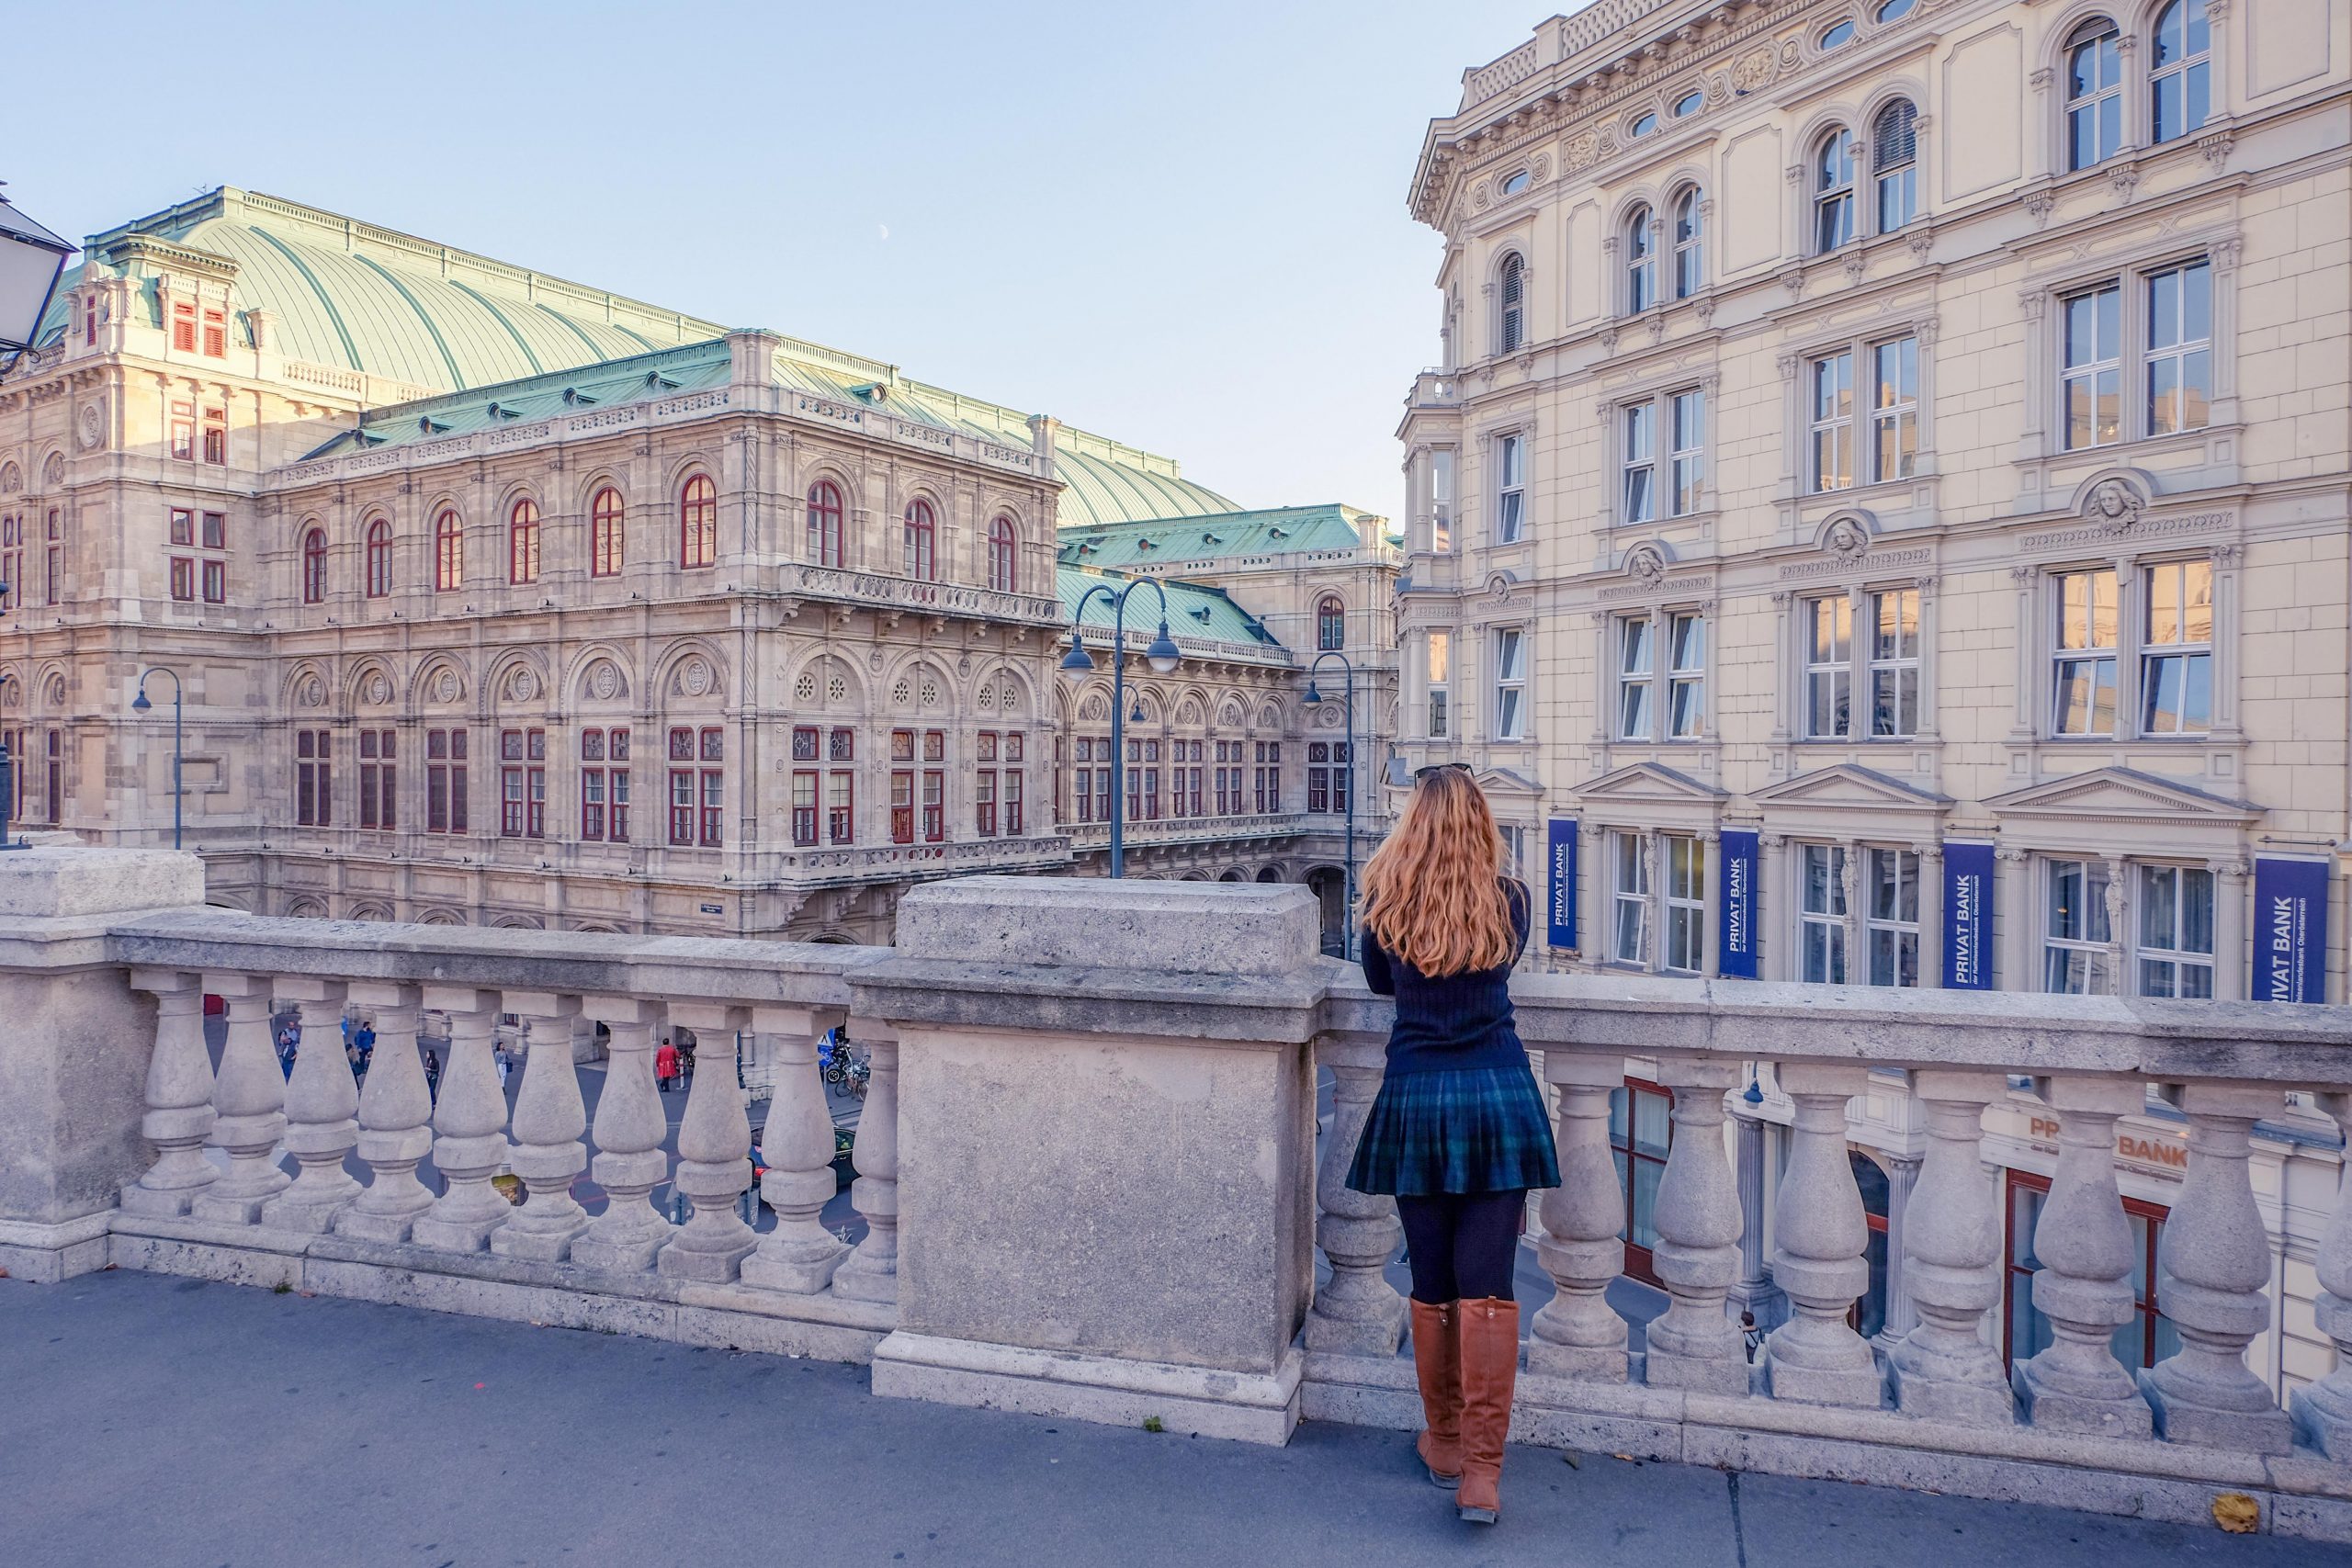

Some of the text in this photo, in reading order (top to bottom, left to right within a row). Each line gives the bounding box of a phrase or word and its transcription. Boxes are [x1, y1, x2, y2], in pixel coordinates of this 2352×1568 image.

[1555, 843, 1564, 926] PRIVAT BANK
[1729, 858, 1740, 952] PRIVAT BANK
[2297, 897, 2306, 946] Oberösterreich
[1955, 874, 1970, 984] PRIVAT BANK
[2271, 897, 2292, 1003] IVAT BANK
[2119, 1135, 2188, 1168] BANK
